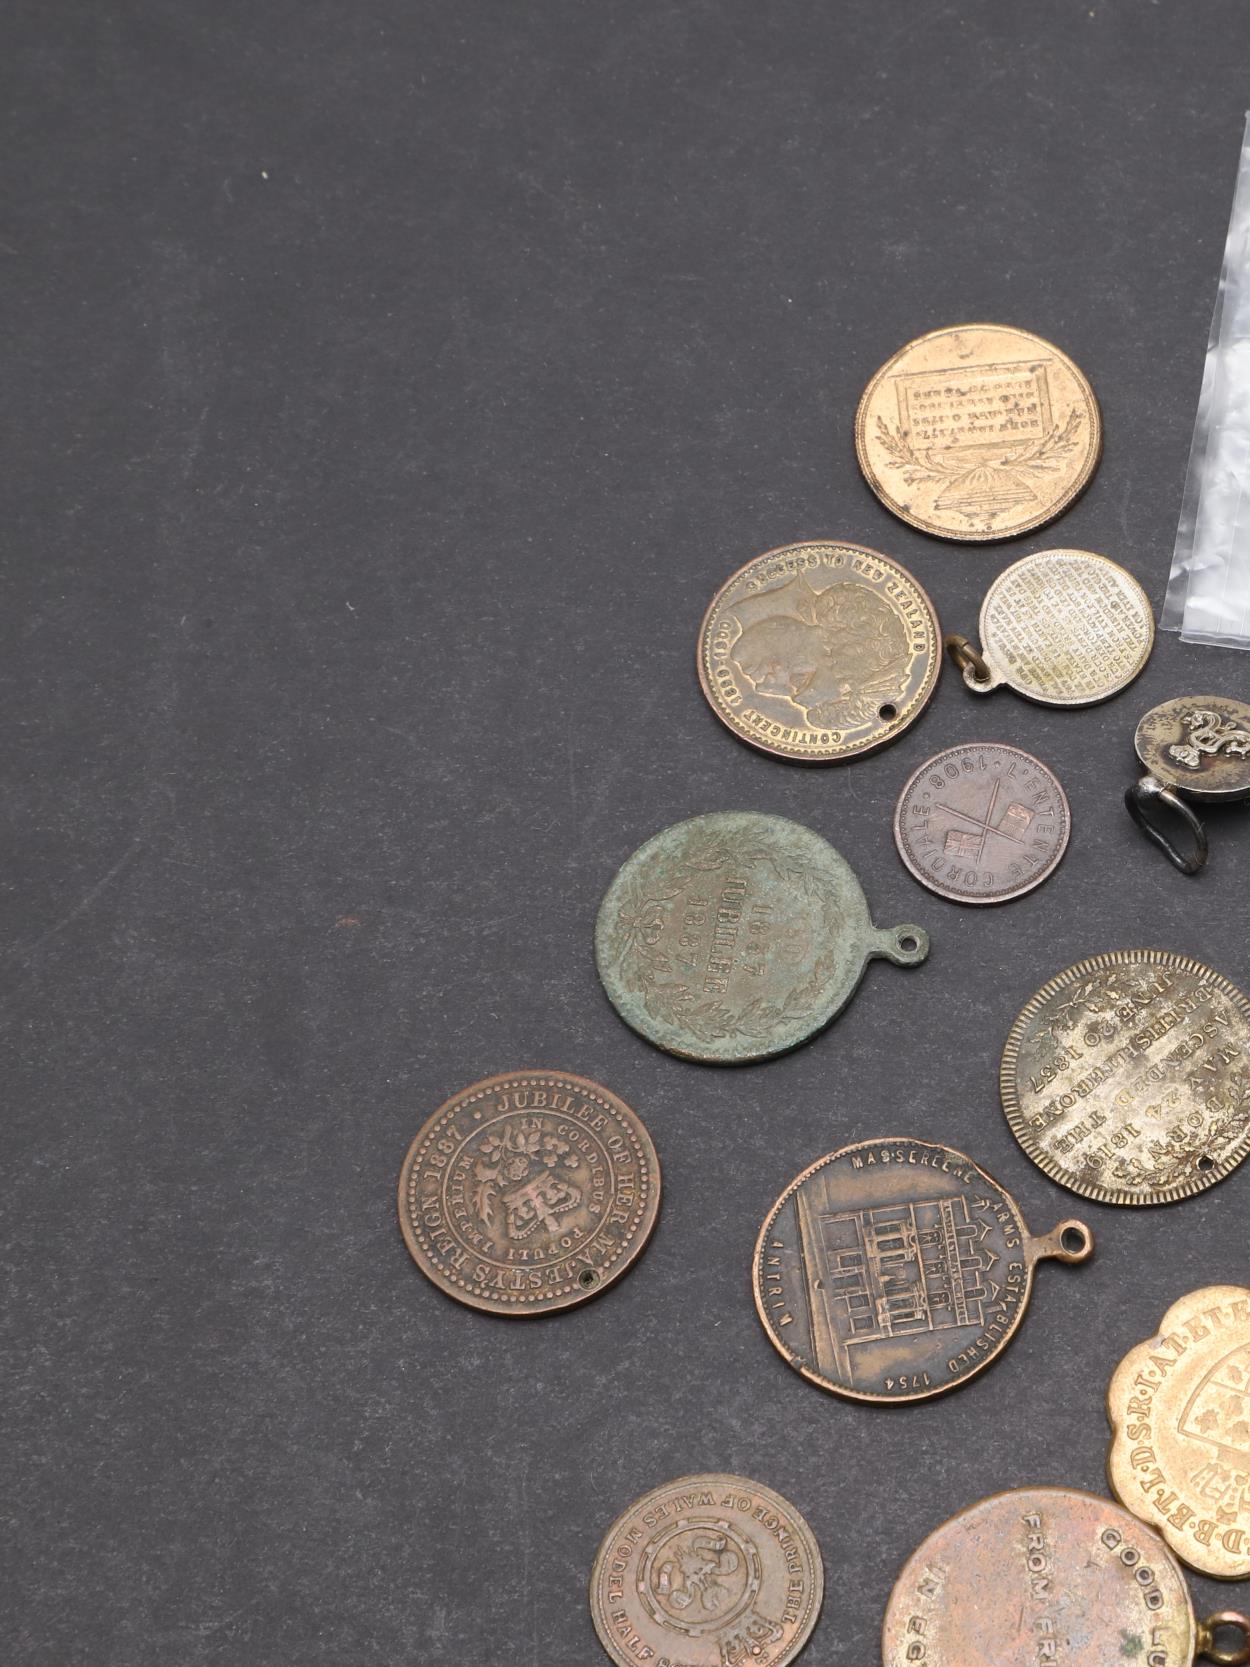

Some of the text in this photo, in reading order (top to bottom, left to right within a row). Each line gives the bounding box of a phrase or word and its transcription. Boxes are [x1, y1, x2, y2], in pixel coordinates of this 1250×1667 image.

[746, 554, 821, 591] SUCCESS
[824, 553, 845, 568] TO
[853, 559, 885, 582] NEW
[885, 581, 927, 652] ZEALAND
[742, 709, 842, 745] CONTINGENT
[928, 754, 987, 790] 1908
[912, 804, 994, 888] CORDIALE
[676, 897, 709, 968] 1887
[1028, 970, 1176, 1094] JUNE 20 1837
[1053, 1010, 1231, 1156] ASCENDED THE
[1087, 1040, 1241, 1171] MAY 24 1819
[1151, 1096, 1225, 1162] BORN
[422, 1090, 635, 1292] JUBILEE OF HER MAJESTY'S REIGN 1887
[451, 1117, 607, 1261] IN CORDIBUS POPULI IMPERIUM
[991, 1202, 1020, 1250] ARMS
[764, 1240, 794, 1328] ANTRIM
[947, 1261, 1023, 1374] ESTABLISHED
[882, 1371, 932, 1391] 1754
[606, 1490, 805, 1661] THE PRINCE OF WALES MODEL HALF
[1022, 1512, 1049, 1602] FROM
[1100, 1527, 1165, 1611] GOOD
